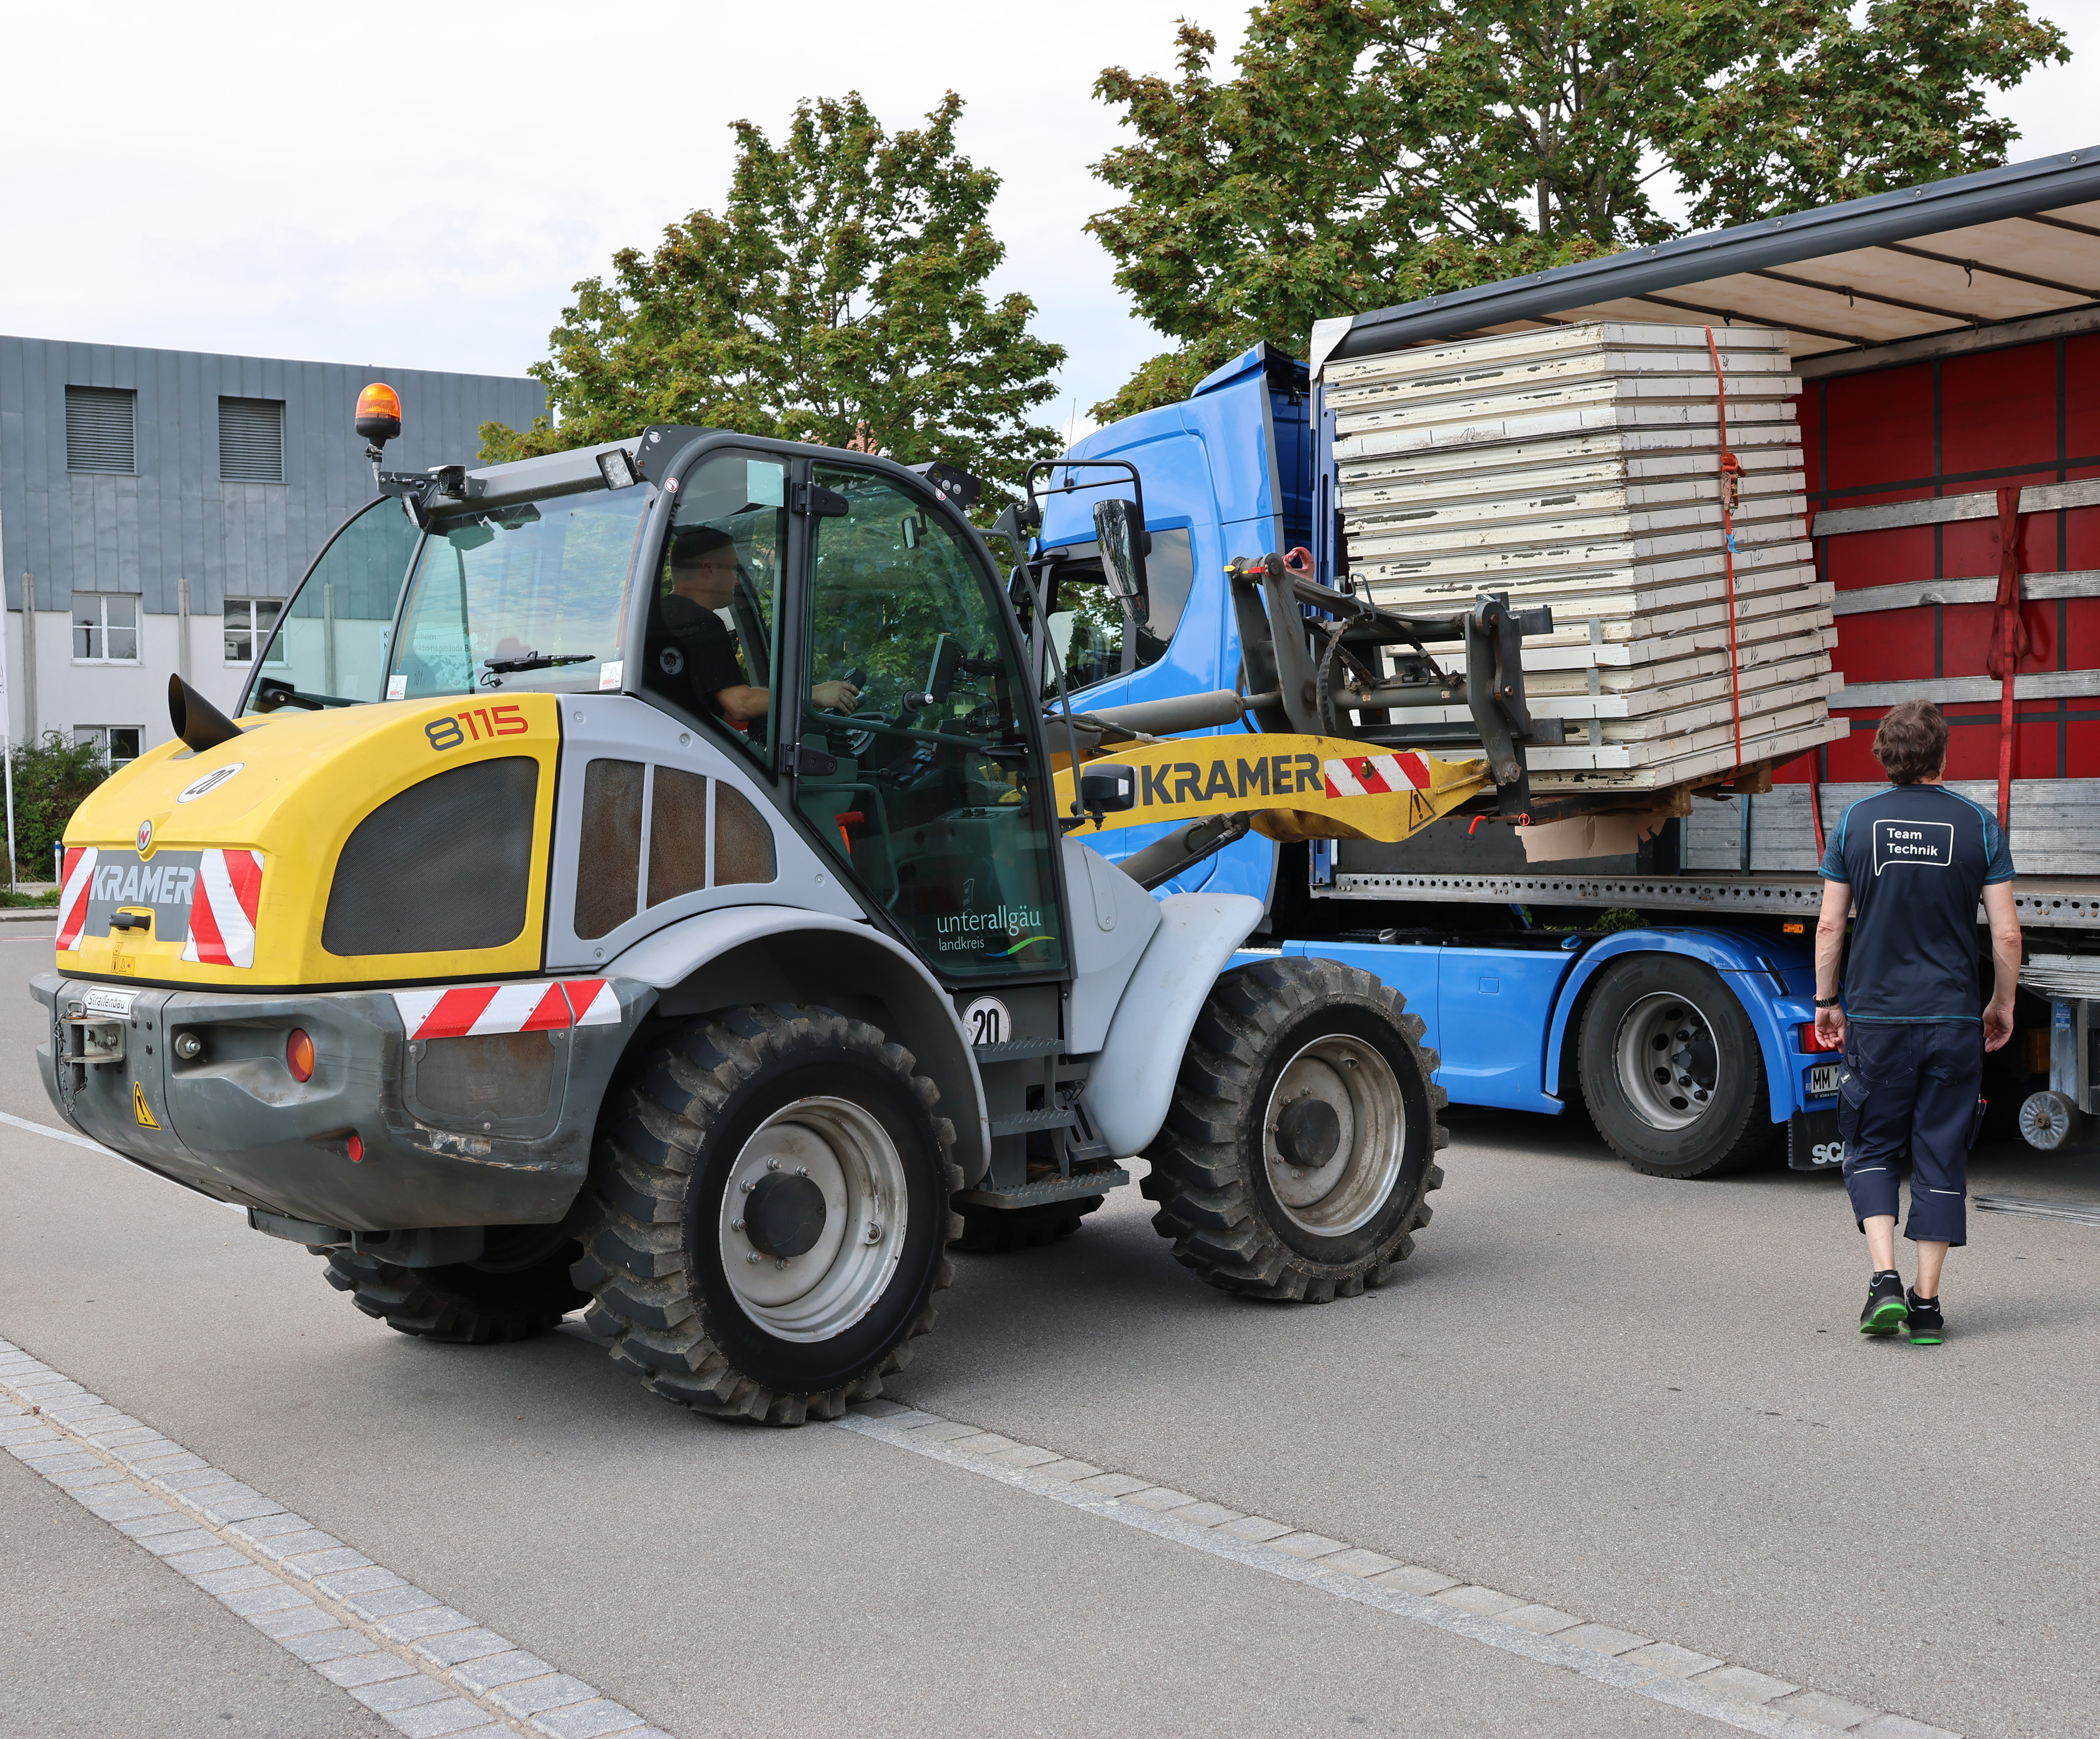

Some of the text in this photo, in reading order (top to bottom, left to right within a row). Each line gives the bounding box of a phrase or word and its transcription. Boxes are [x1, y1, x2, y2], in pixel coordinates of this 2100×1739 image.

[1460, 427, 1478, 441] 12
[424, 705, 528, 751] 8115
[184, 769, 235, 795] 20
[1141, 753, 1324, 806] KRAMER
[1886, 828, 1922, 840] Team
[1886, 843, 1938, 856] Technik
[89, 865, 195, 905] KRAMER
[937, 905, 1041, 936] unterallgäu
[939, 936, 985, 951] landkreis
[88, 993, 126, 1009] Straßenbau
[973, 1009, 999, 1046] 20
[1805, 1083, 1811, 1091] RO
[1813, 1068, 1830, 1090] MM
